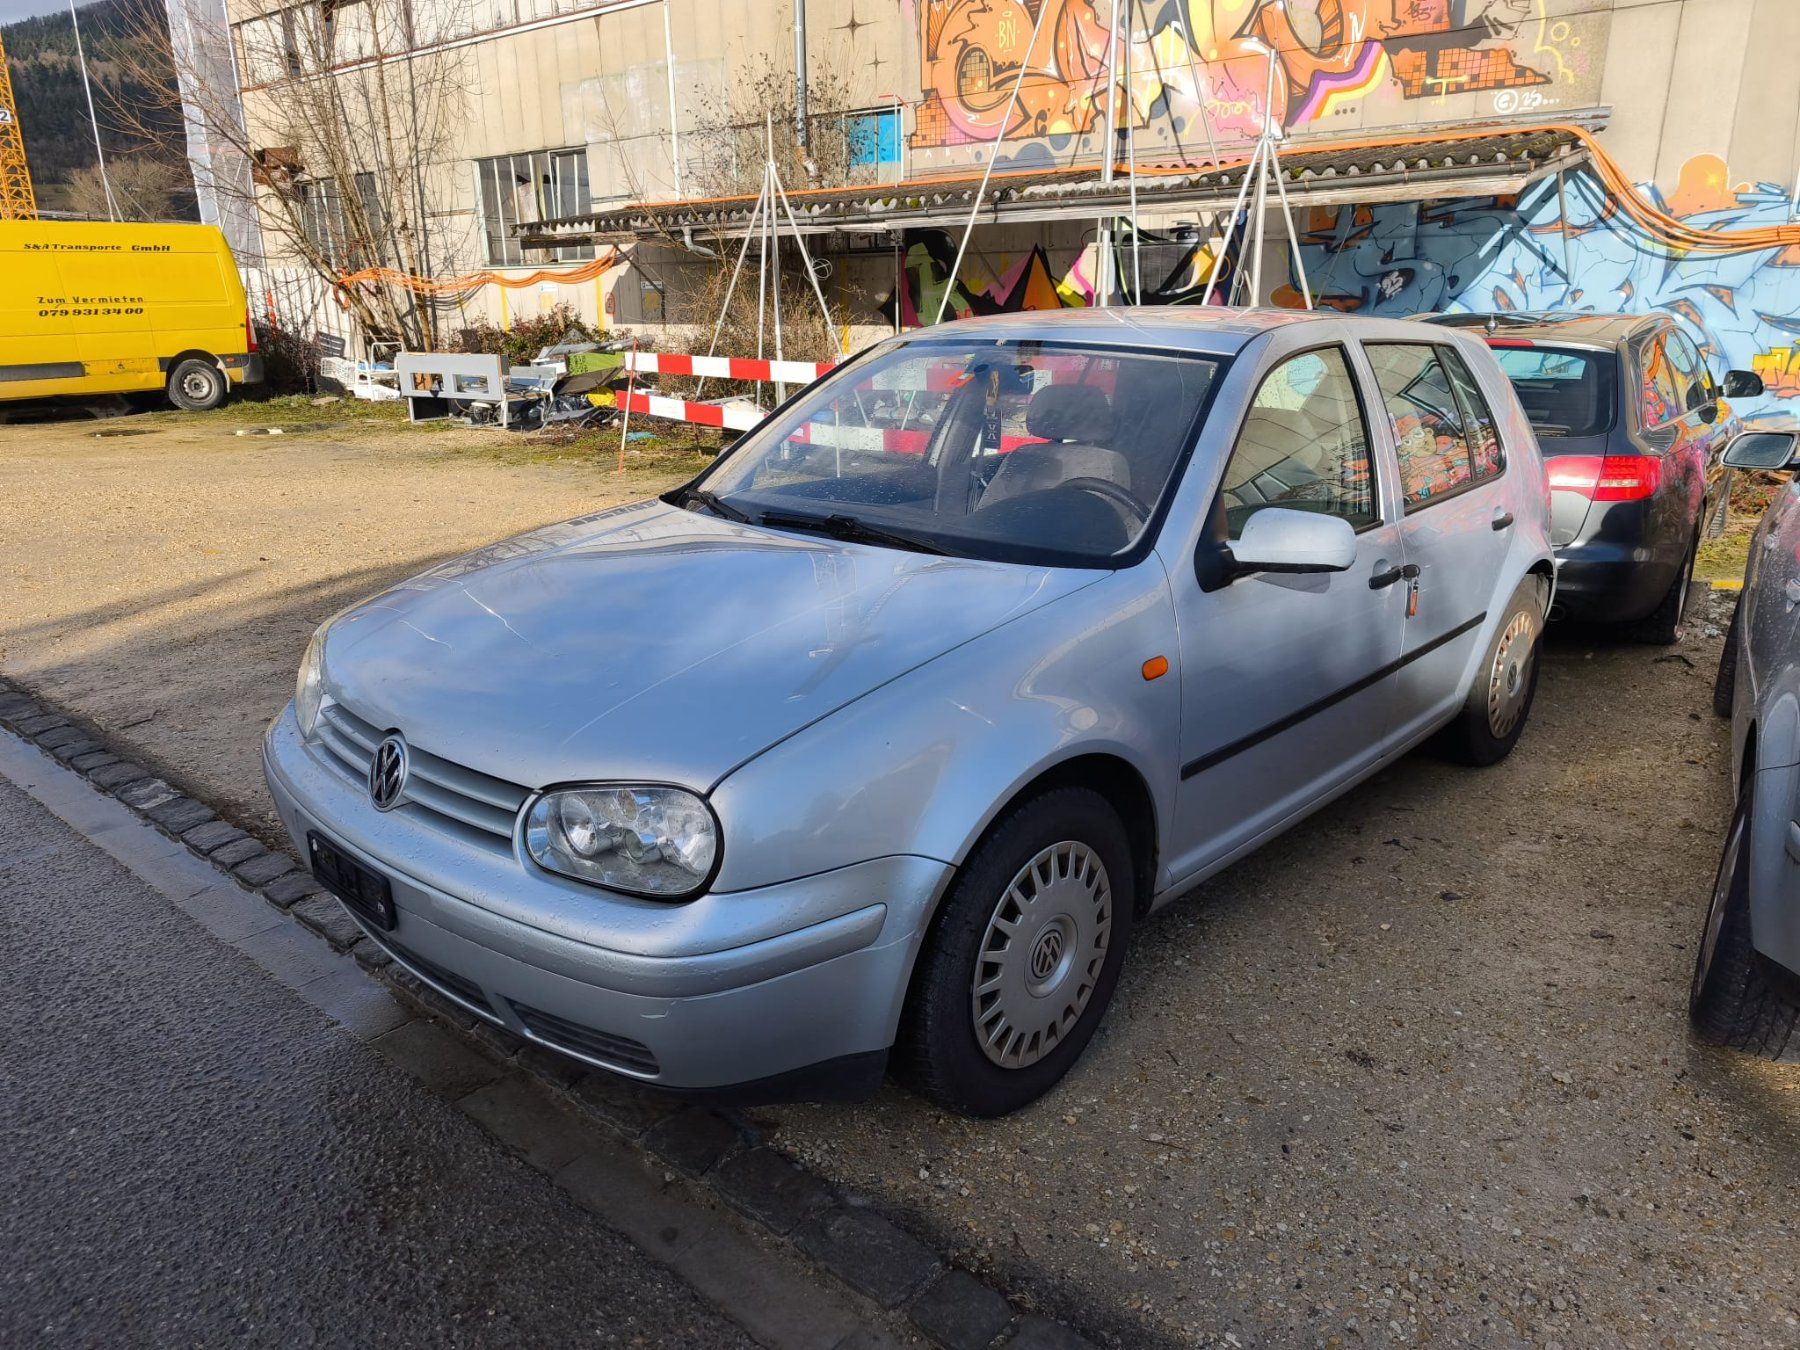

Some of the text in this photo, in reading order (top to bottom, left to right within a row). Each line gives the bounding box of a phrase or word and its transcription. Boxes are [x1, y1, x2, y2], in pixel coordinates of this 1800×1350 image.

[52, 243, 122, 252] Transporte
[131, 244, 171, 252] GmbH
[36, 295, 144, 304] Zum Vermieten
